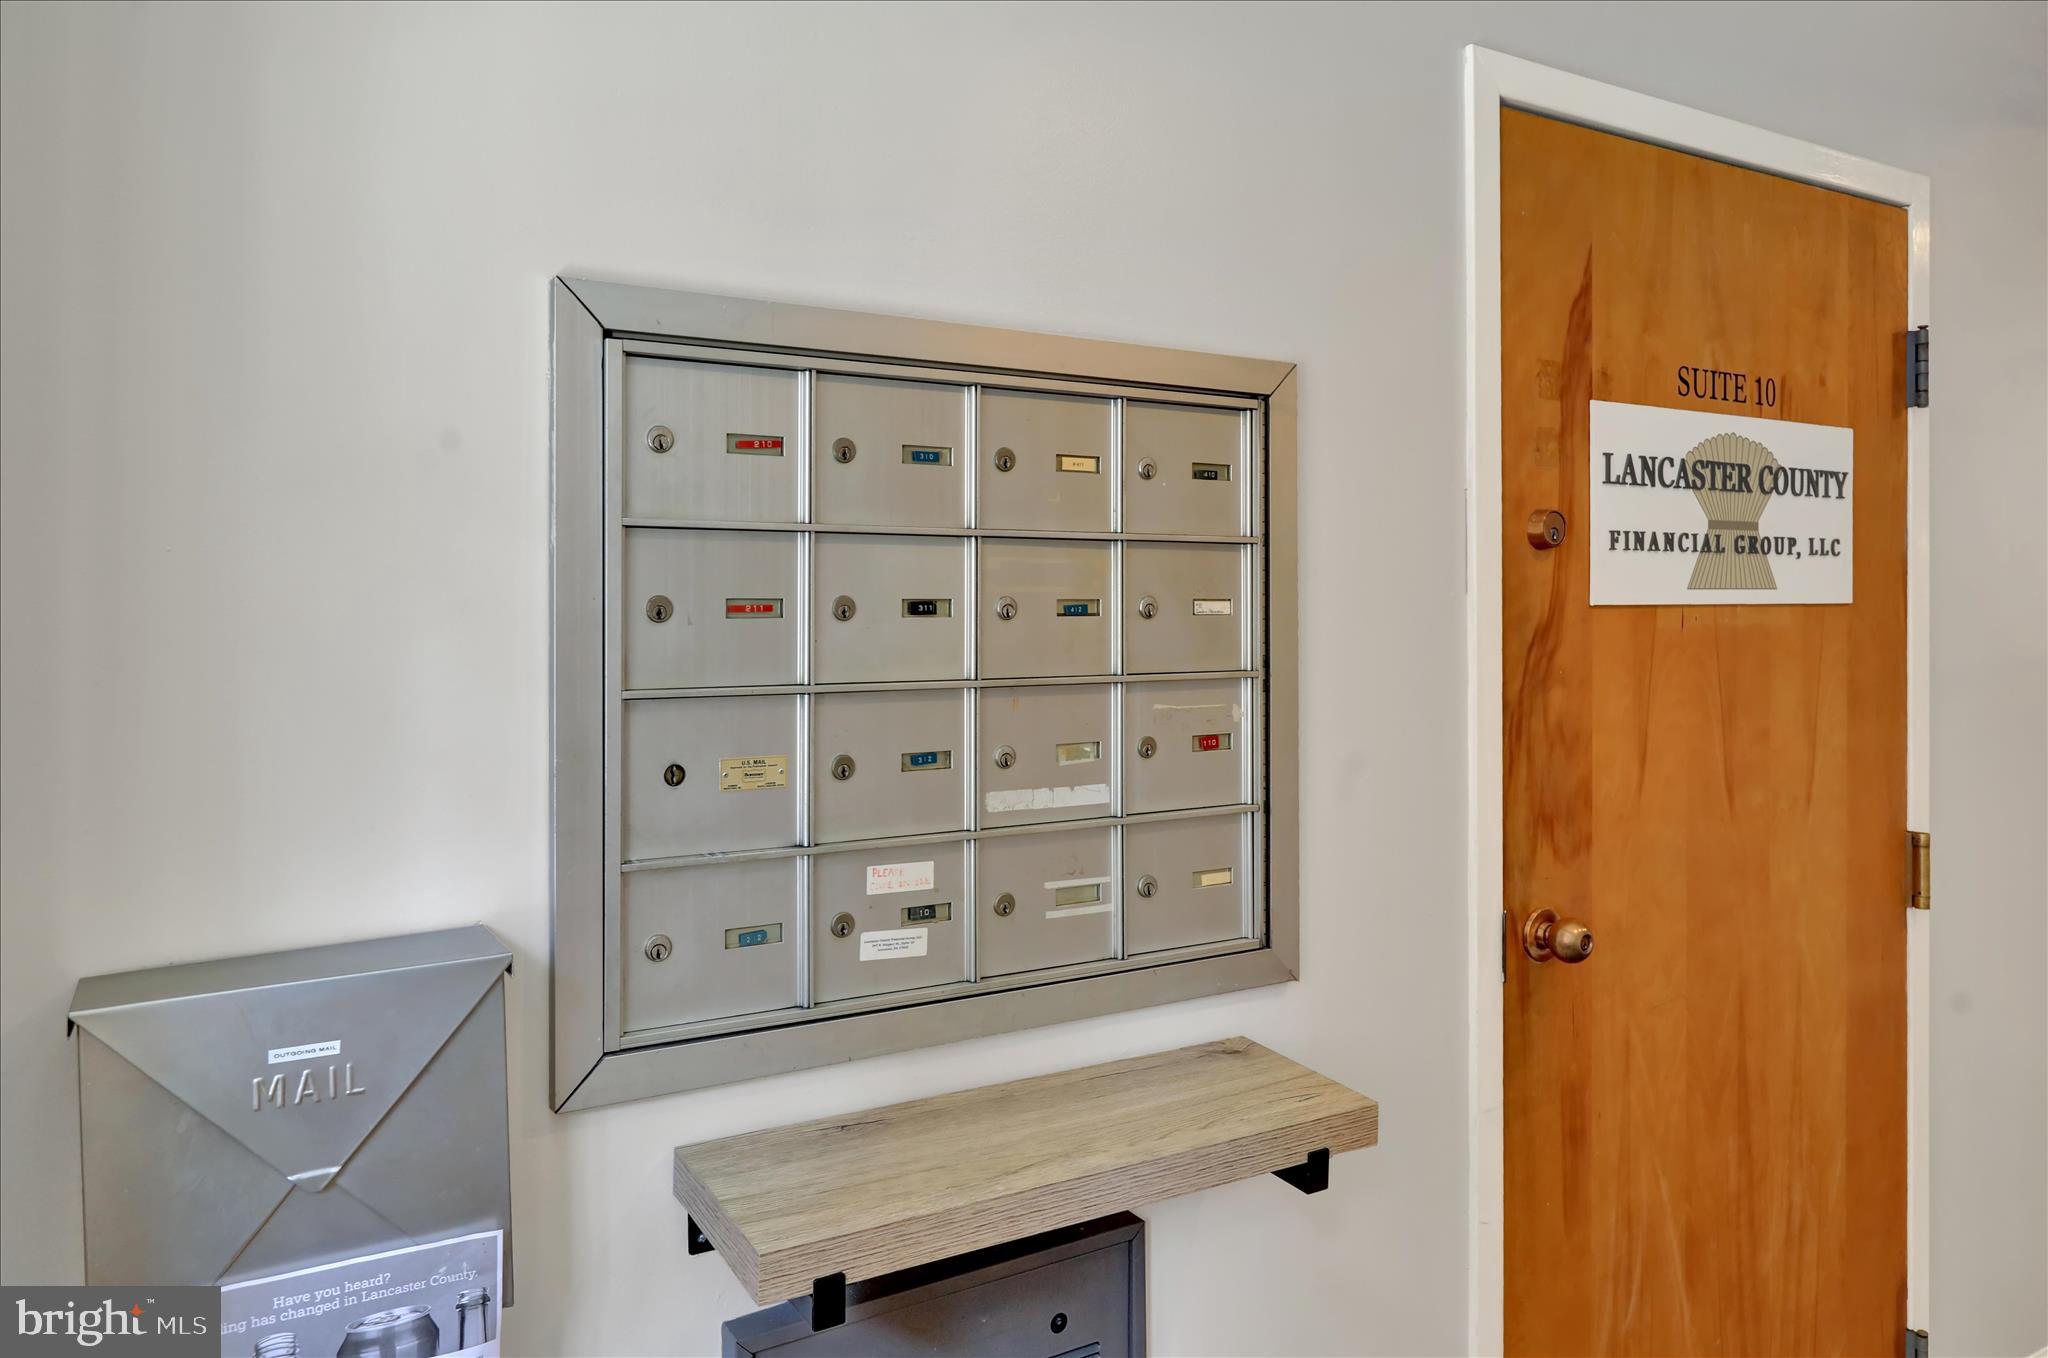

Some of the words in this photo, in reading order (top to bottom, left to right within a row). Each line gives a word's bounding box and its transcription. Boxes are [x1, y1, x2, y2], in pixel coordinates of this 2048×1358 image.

[1677, 365, 1747, 404] SUITE
[1754, 376, 1776, 407] 10
[753, 440, 773, 448] 210
[919, 452, 934, 460] 310
[1602, 452, 1754, 494] LANCASTER
[1758, 464, 1849, 500] COUNTY
[1608, 530, 1726, 555] FINANCIAL
[1733, 534, 1802, 560] GROUP,
[1808, 538, 1842, 557] LLC
[745, 604, 764, 613] 211
[273, 1047, 317, 1059] OUTGOING
[319, 1045, 337, 1053] MAIL
[252, 1062, 367, 1112] MAIL
[250, 1315, 277, 1329] has
[279, 1298, 341, 1322] changed
[343, 1295, 358, 1307] in
[361, 1279, 427, 1303] Lancaster
[272, 1292, 311, 1310] Have
[314, 1286, 341, 1301] you
[344, 1272, 391, 1293] heard?
